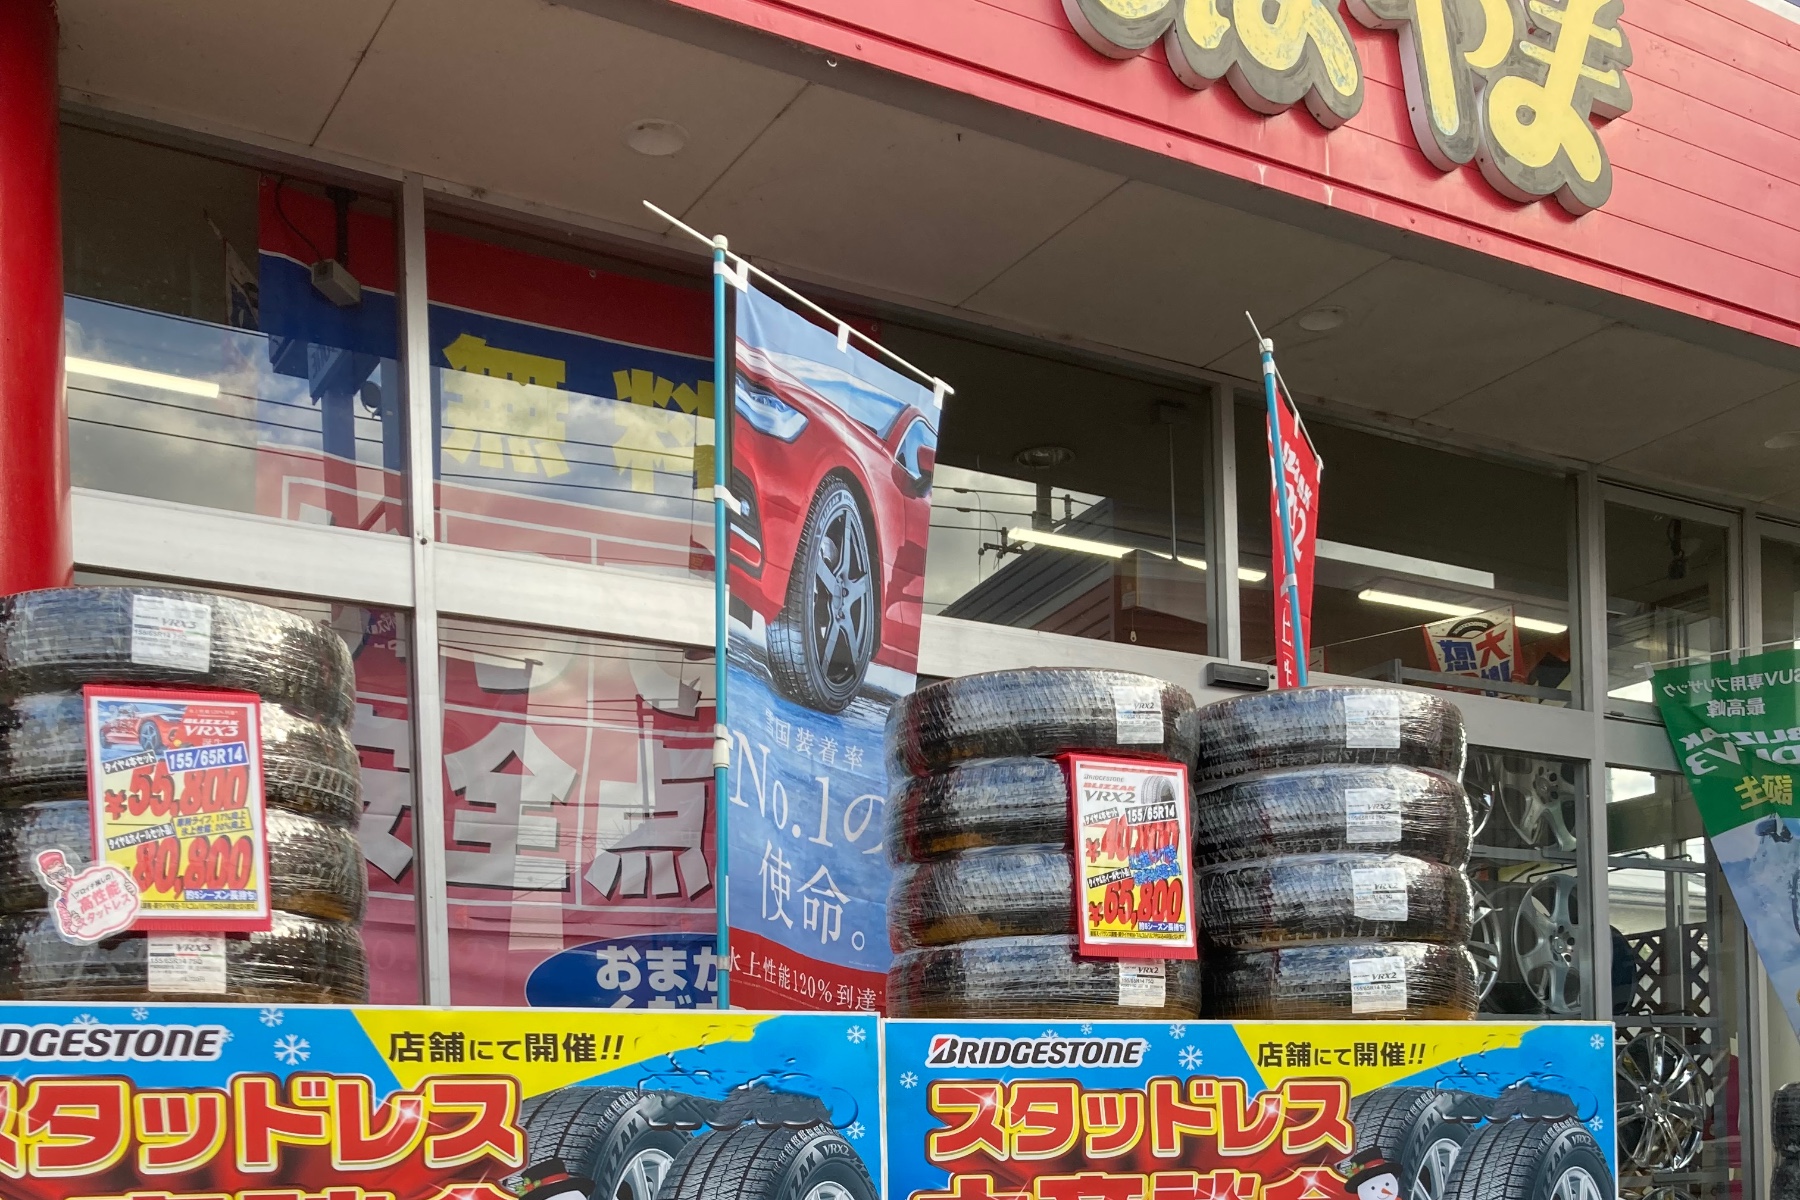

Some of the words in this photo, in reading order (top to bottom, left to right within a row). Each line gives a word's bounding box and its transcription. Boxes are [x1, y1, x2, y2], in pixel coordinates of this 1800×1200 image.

[183, 718, 240, 726] BLIZZAK
[184, 725, 239, 737] VRX3
[765, 708, 863, 770] 雪国装着率
[104, 753, 155, 774] タイヤ4本セット
[169, 749, 243, 770] 155/65R14
[730, 729, 885, 855] No.1の
[1083, 782, 1136, 791] BLIZZAK
[1084, 790, 1136, 804] VRX2
[1127, 804, 1176, 823] 155/65R14
[1367, 802, 1392, 811] VRX2
[758, 839, 866, 951] 使命。
[1374, 882, 1399, 890] VRX2
[77, 881, 122, 914] 高性能
[1088, 878, 1184, 930] ¥65,800
[175, 943, 212, 952] VRX3
[1138, 966, 1159, 974] VRX2
[1372, 971, 1397, 981] VRX2
[389, 1031, 625, 1063] 店舗にて開催!!
[929, 1037, 1142, 1065] BRIDGESTONE
[1256, 1040, 1425, 1068] 店舗にて開催!!
[0, 1076, 526, 1176] タッドレス
[931, 1078, 1352, 1158] スタッドレス
[823, 1143, 850, 1157] VRX2
